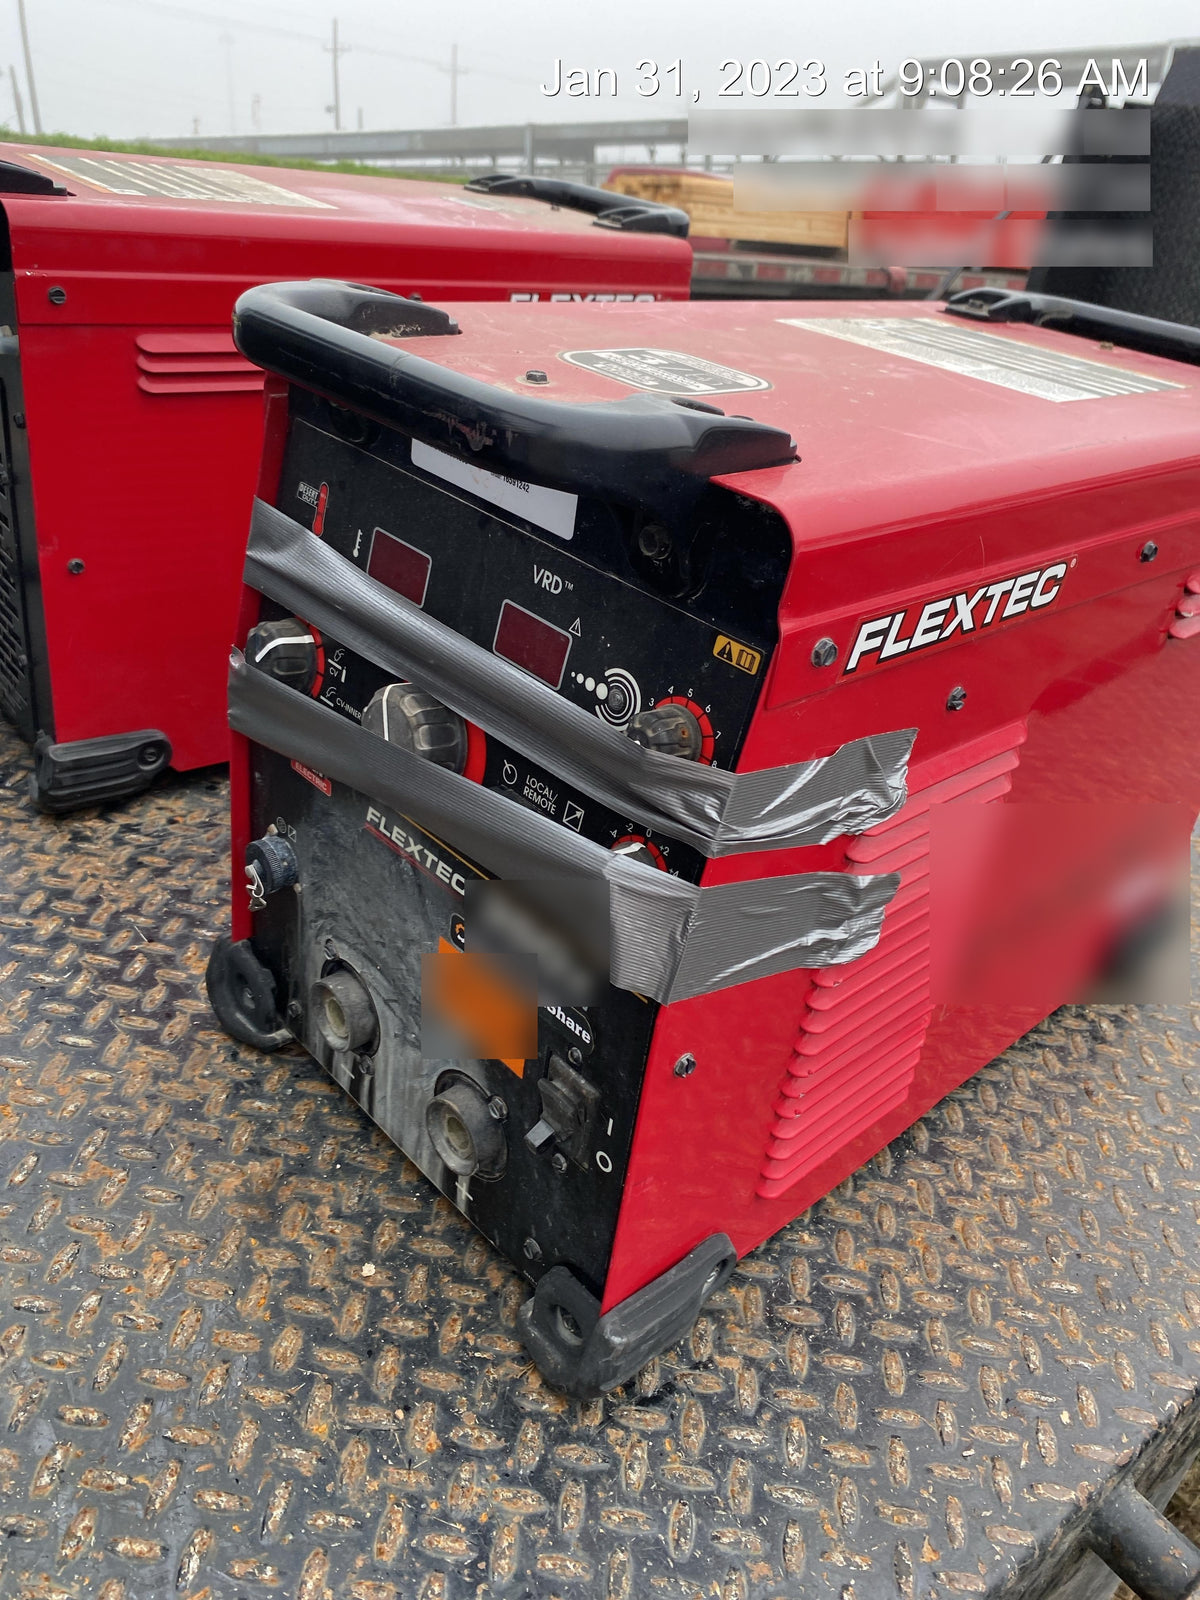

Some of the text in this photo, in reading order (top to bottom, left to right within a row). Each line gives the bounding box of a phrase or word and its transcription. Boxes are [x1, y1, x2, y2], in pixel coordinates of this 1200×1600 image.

[843, 562, 1069, 673] FLEXTEC
[668, 685, 674, 695] 4
[687, 688, 694, 698] 5
[648, 697, 655, 707] 3
[705, 704, 711, 713] 6
[715, 730, 722, 740] 7
[295, 761, 328, 791] ELECTRIC
[523, 786, 557, 815] REMOTE
[366, 806, 465, 897] FLEXTEC
